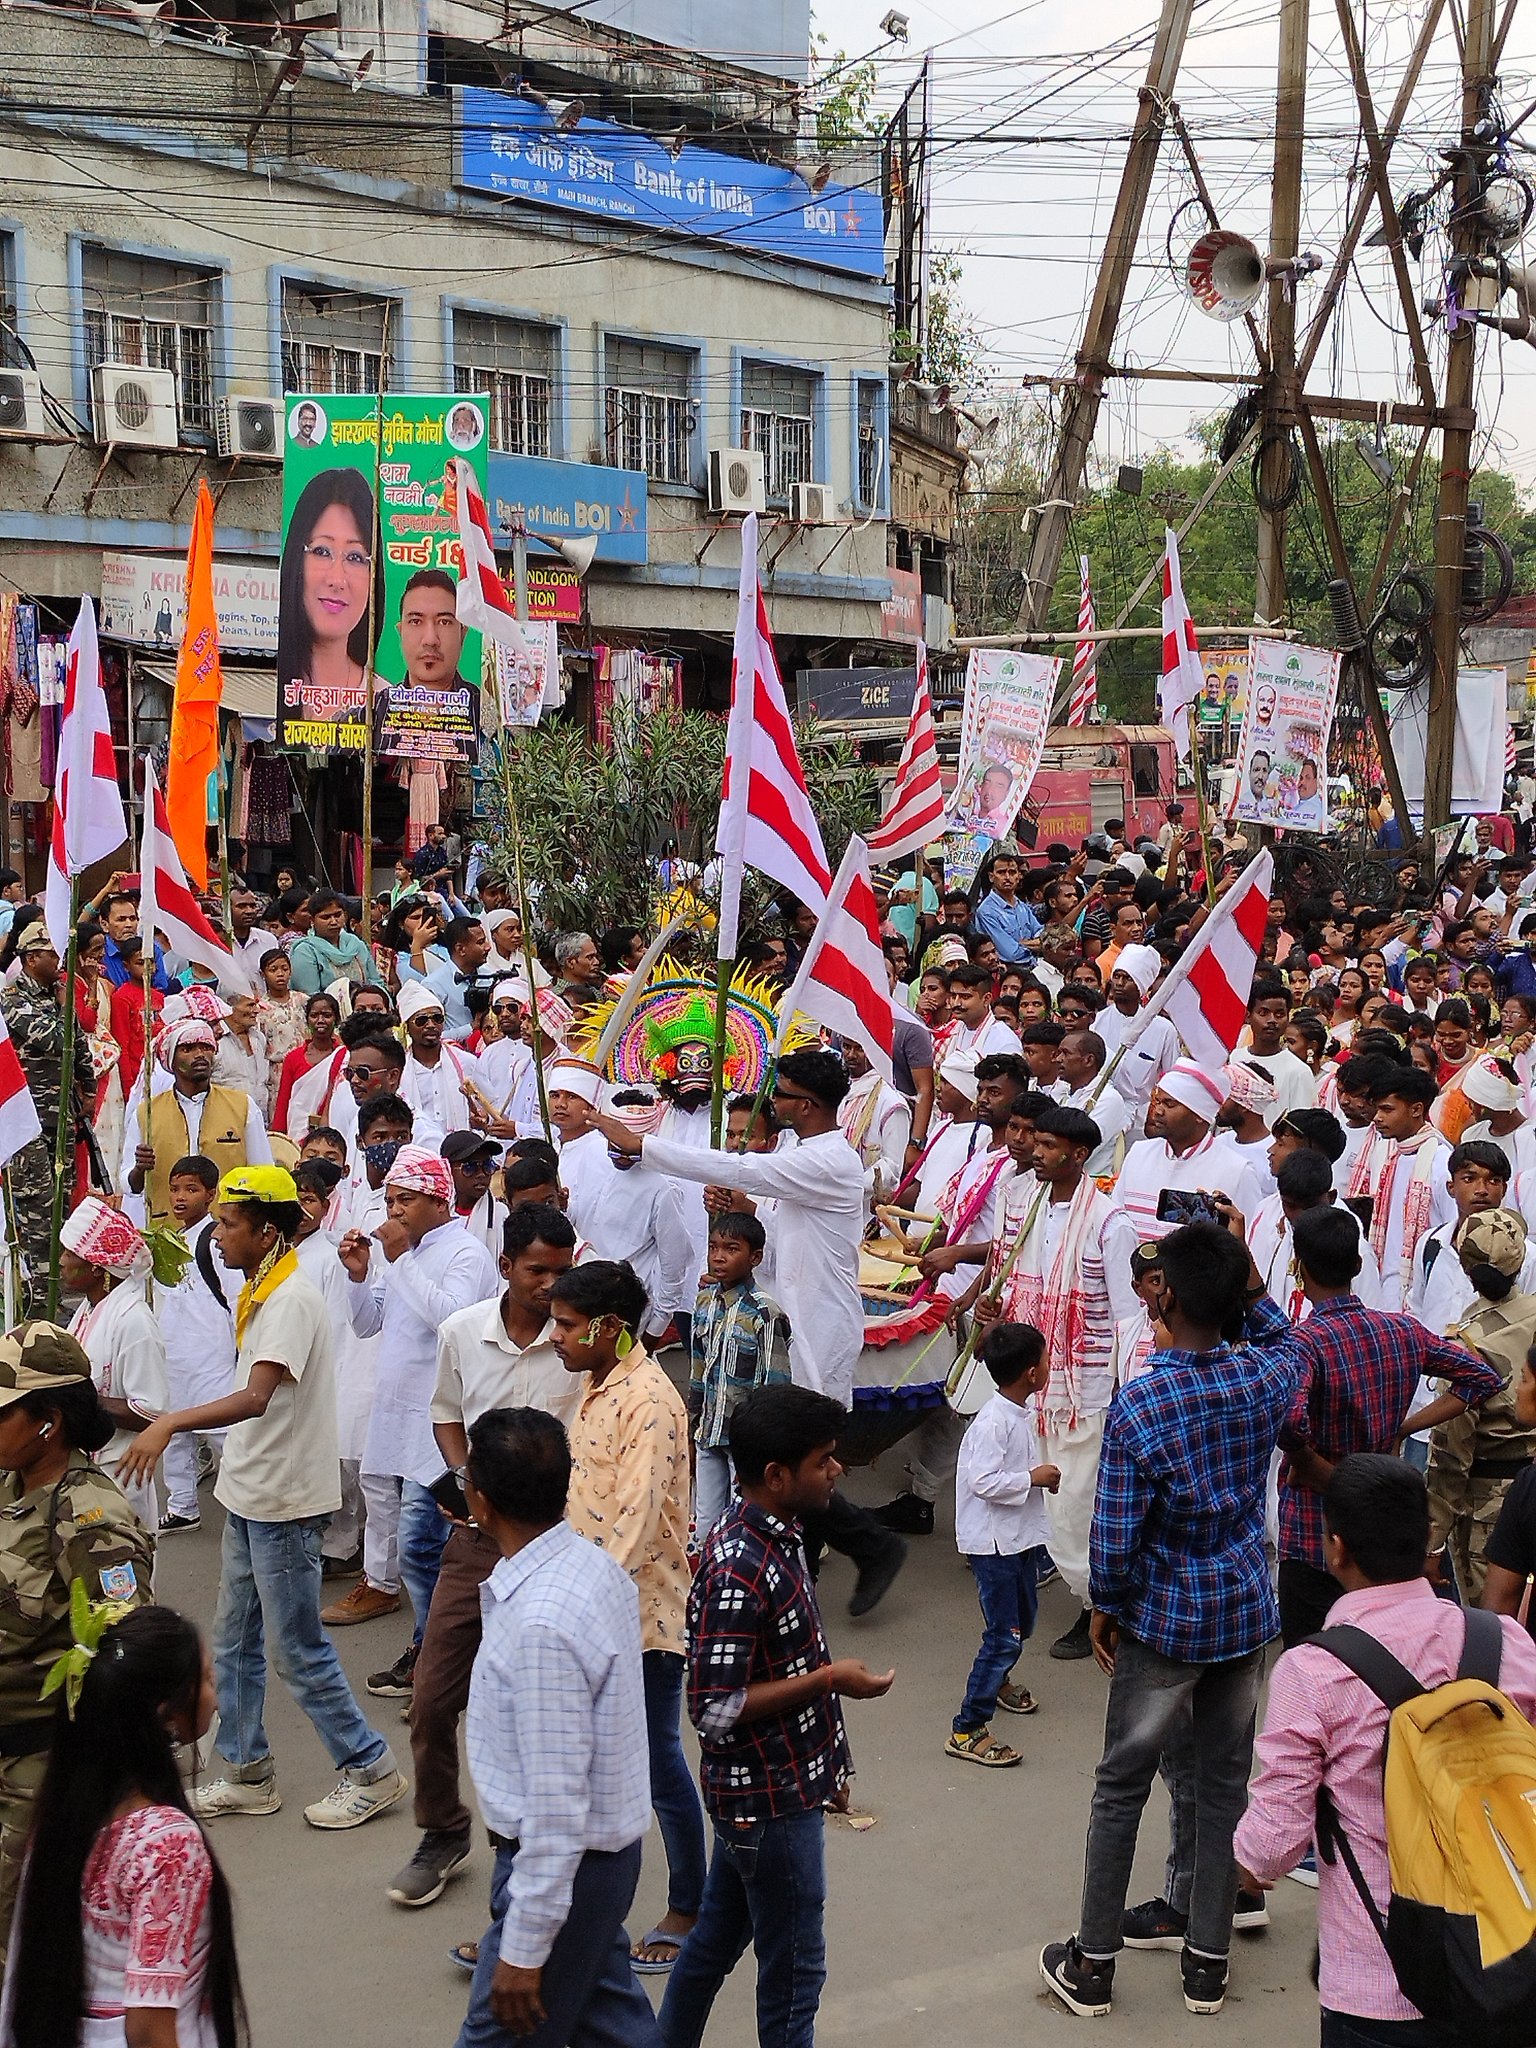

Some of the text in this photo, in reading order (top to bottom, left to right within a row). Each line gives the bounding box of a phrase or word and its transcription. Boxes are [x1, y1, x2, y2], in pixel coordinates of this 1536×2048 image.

[558, 188, 576, 202] MAIN
[634, 160, 753, 216] Bank of India
[803, 203, 836, 236] BOI
[382, 412, 414, 456] मुक्ति
[415, 413, 445, 445] मोर्चा
[380, 464, 410, 484] राम
[384, 482, 423, 507] नवमी
[528, 505, 540, 522] of
[542, 505, 570, 527] India
[574, 501, 610, 531] BOI
[387, 537, 462, 567] वार्ड 18
[102, 563, 136, 575] KRISHNA
[509, 569, 580, 588] HNDLOOM
[219, 626, 251, 637] Jeans,
[251, 614, 270, 626] Top,
[302, 686, 341, 716] महुआ
[438, 688, 470, 706] माजी
[284, 720, 338, 746] राज्यसभा
[339, 715, 367, 749] सांस
